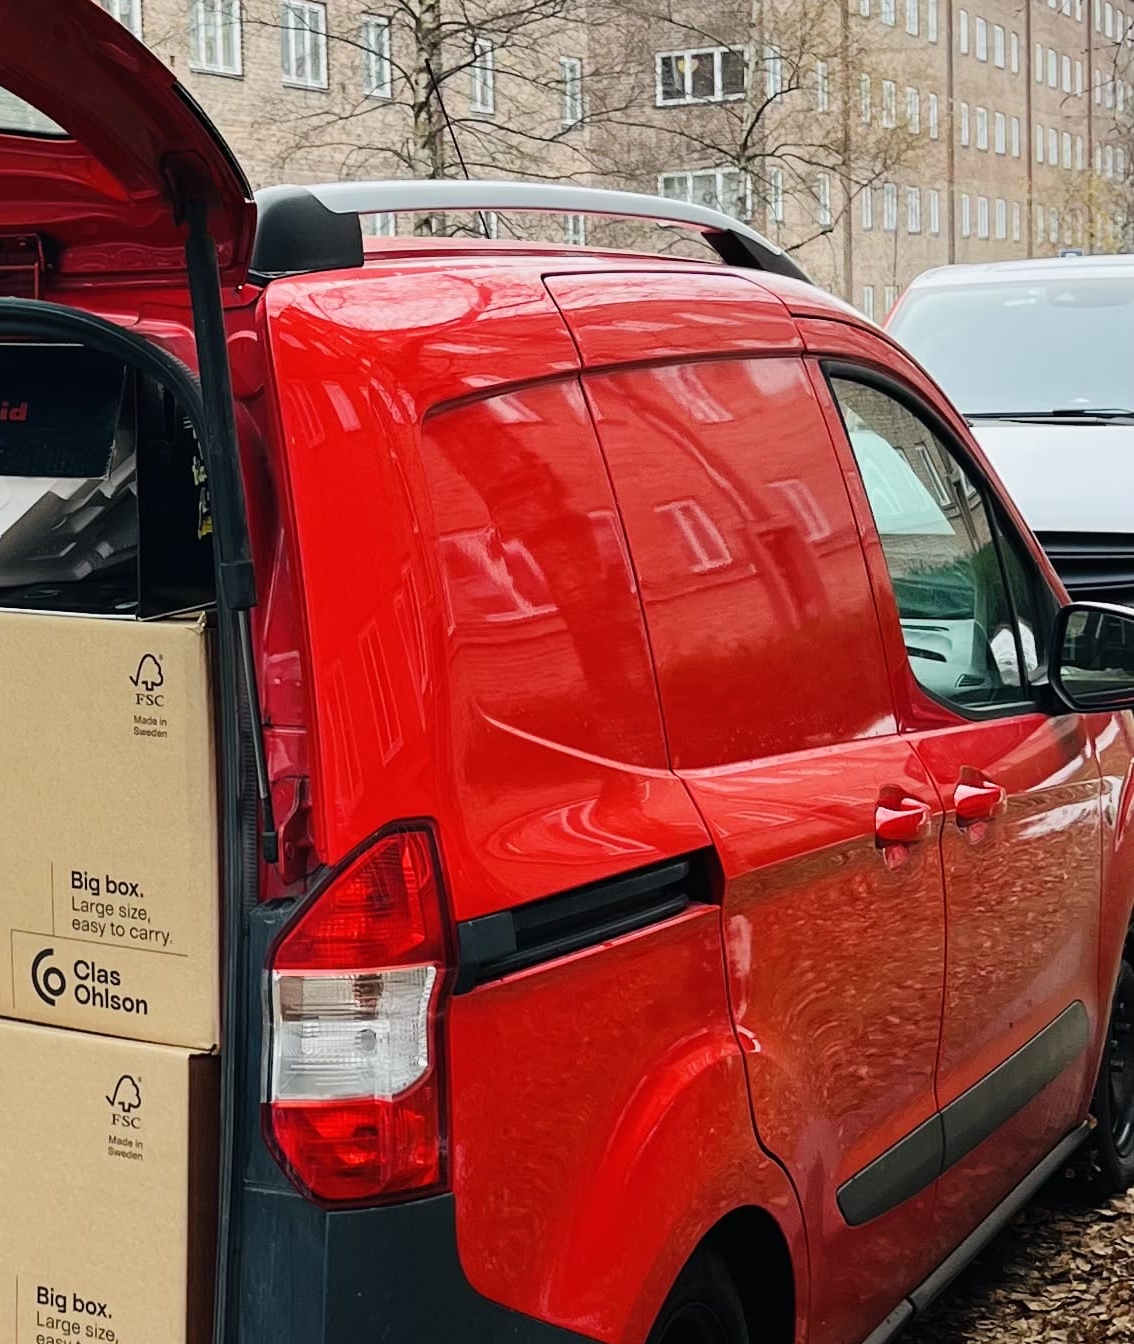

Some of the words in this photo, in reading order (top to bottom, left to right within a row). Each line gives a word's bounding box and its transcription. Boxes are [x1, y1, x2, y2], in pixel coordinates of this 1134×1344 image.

[135, 693, 164, 707] FSC
[133, 715, 158, 726] Made
[159, 717, 167, 726] in
[133, 727, 168, 738] Sweden
[71, 870, 100, 896] Big
[105, 874, 144, 898] box.
[71, 896, 114, 918] Large
[118, 903, 151, 923] size,
[71, 918, 107, 937] easy
[111, 922, 126, 937] to
[129, 927, 173, 946] carry.
[73, 959, 121, 986] Clas
[74, 984, 148, 1015] Ohlson
[111, 1113, 141, 1129] FSC
[107, 1146, 144, 1161] Sweden
[108, 1135, 133, 1148] Made
[135, 1139, 143, 1149] in
[36, 1286, 67, 1313] Big
[72, 1293, 112, 1319] box.
[36, 1311, 81, 1336] Large
[85, 1323, 119, 1344] size,
